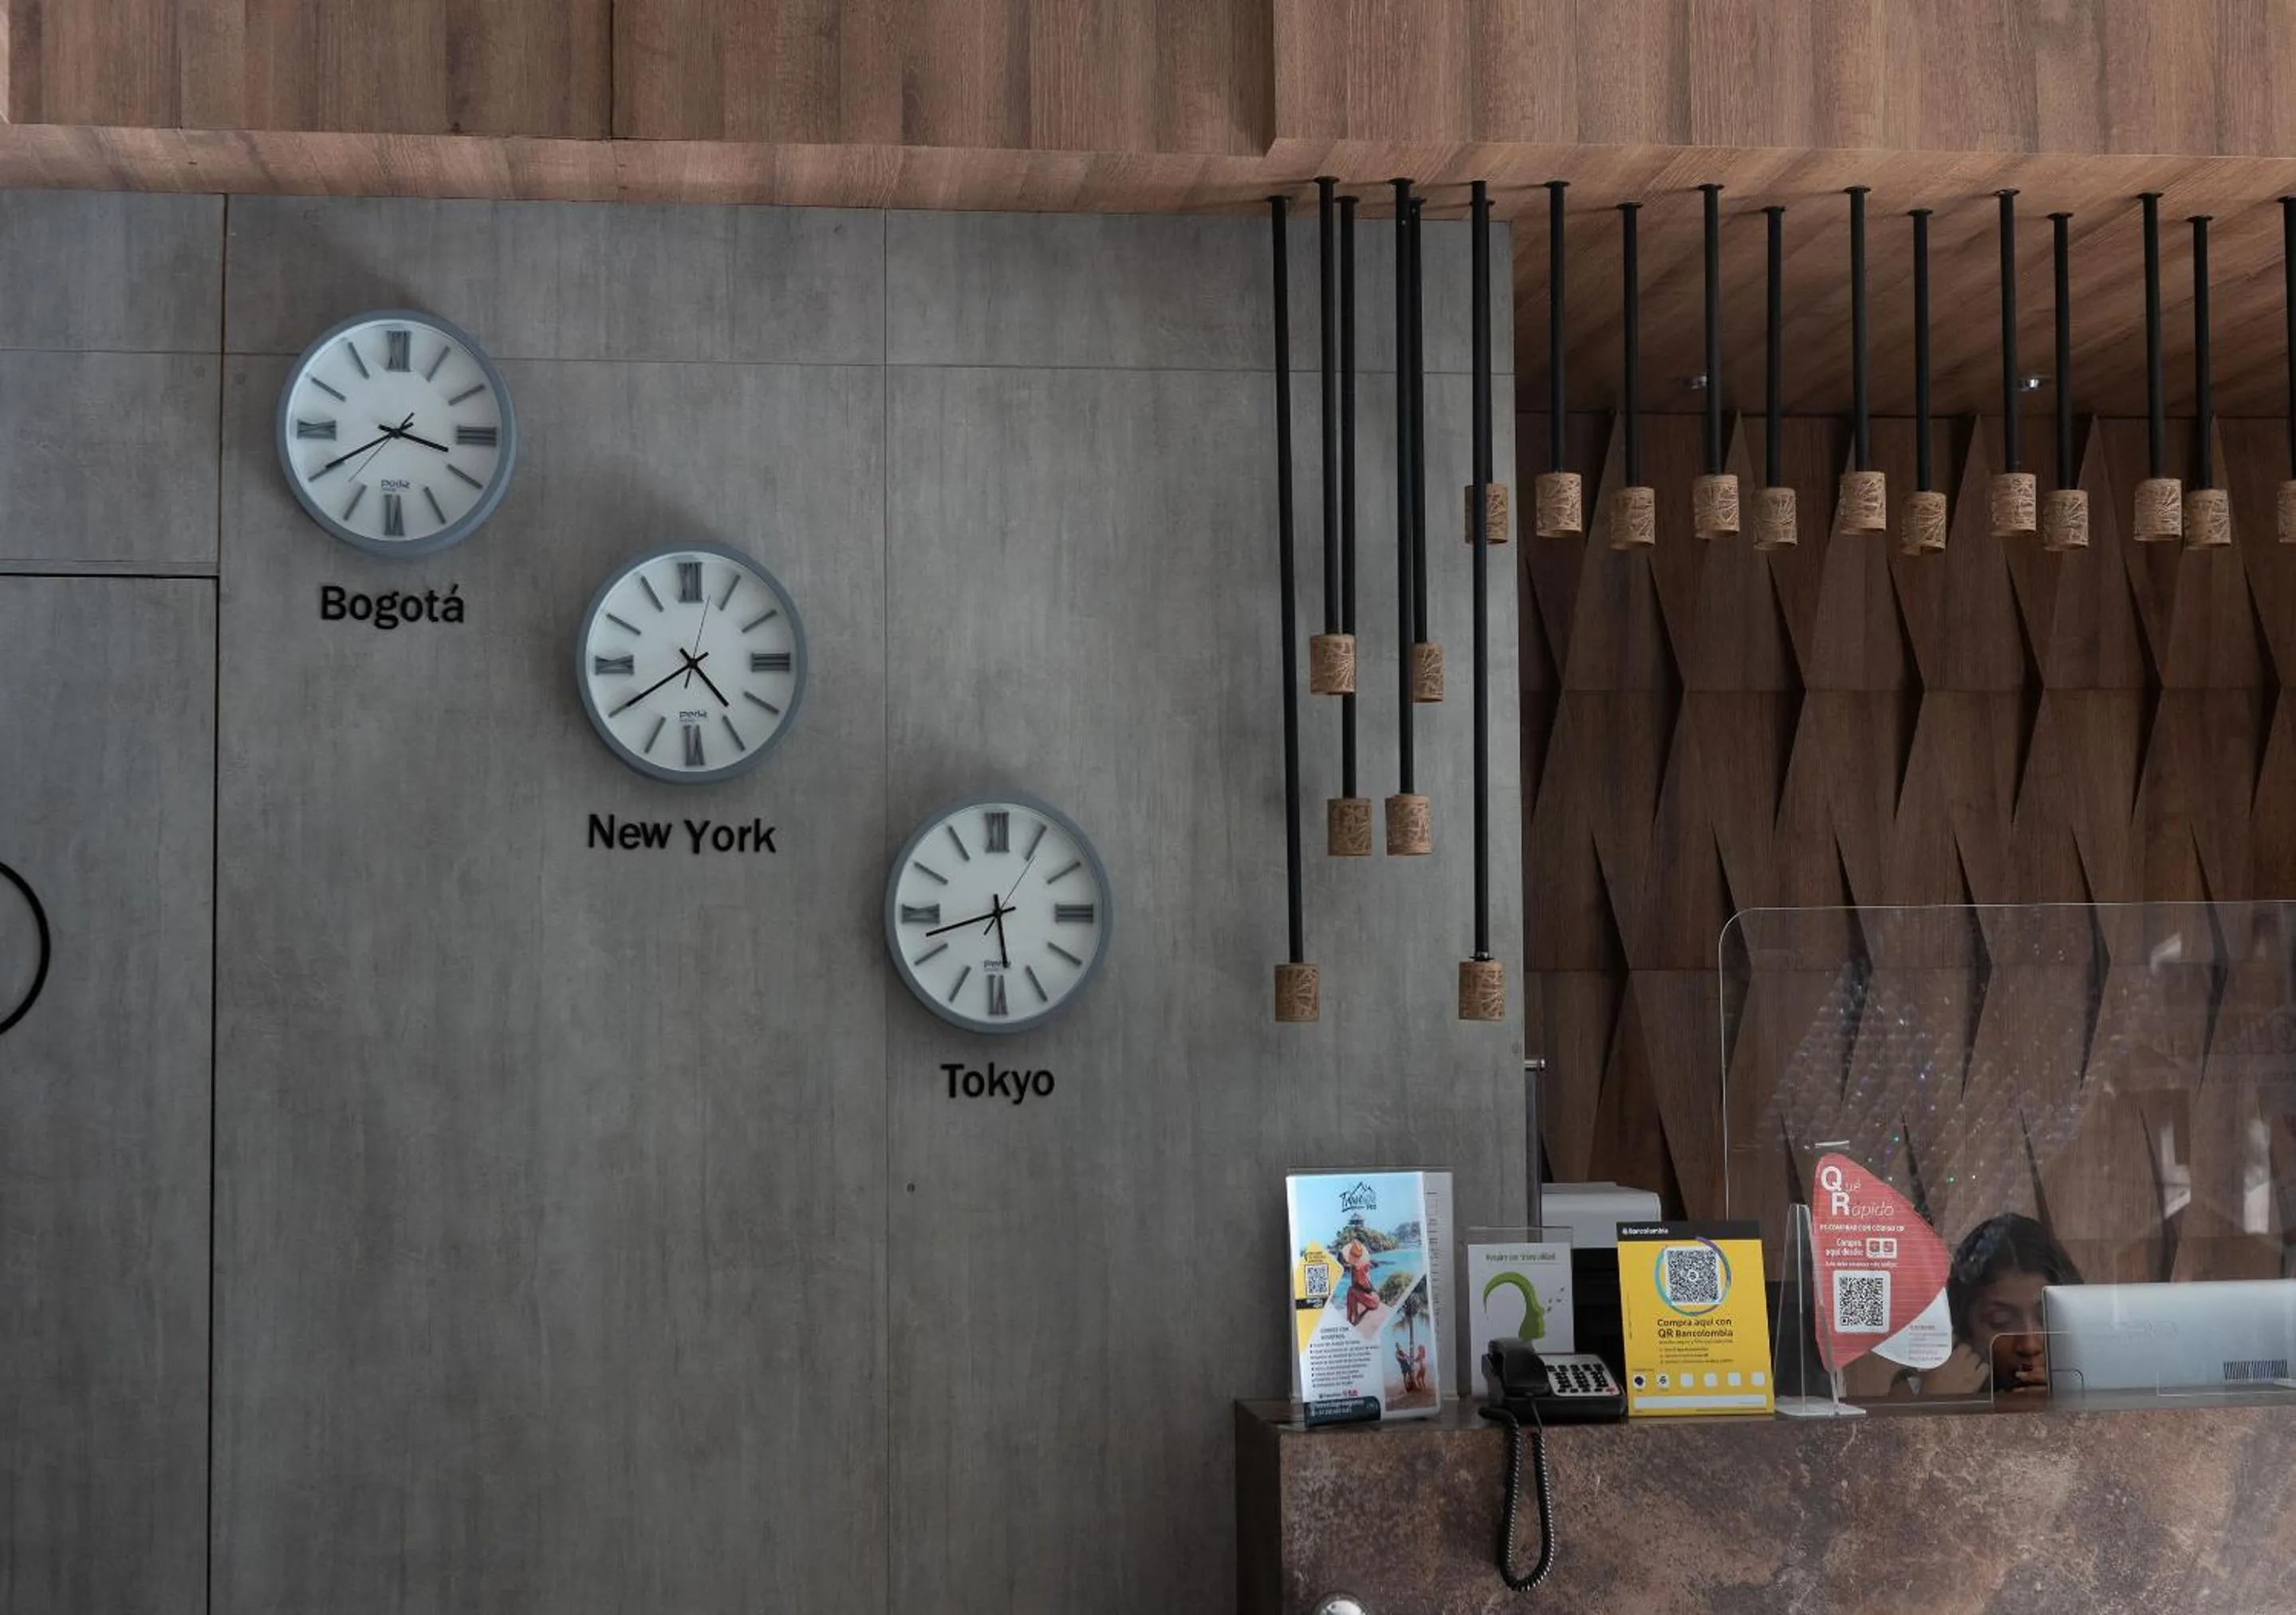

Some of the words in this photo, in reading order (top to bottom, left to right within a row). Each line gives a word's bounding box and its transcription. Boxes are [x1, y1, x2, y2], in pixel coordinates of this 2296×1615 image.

[321, 583, 465, 630] Bogotá
[587, 813, 673, 851] New
[683, 817, 778, 855] York
[940, 1062, 1056, 1105] Tokyo
[1657, 1318, 1692, 1328] Compra
[1658, 1329, 1674, 1338] QR
[1676, 1329, 1734, 1337] Bancolombia
